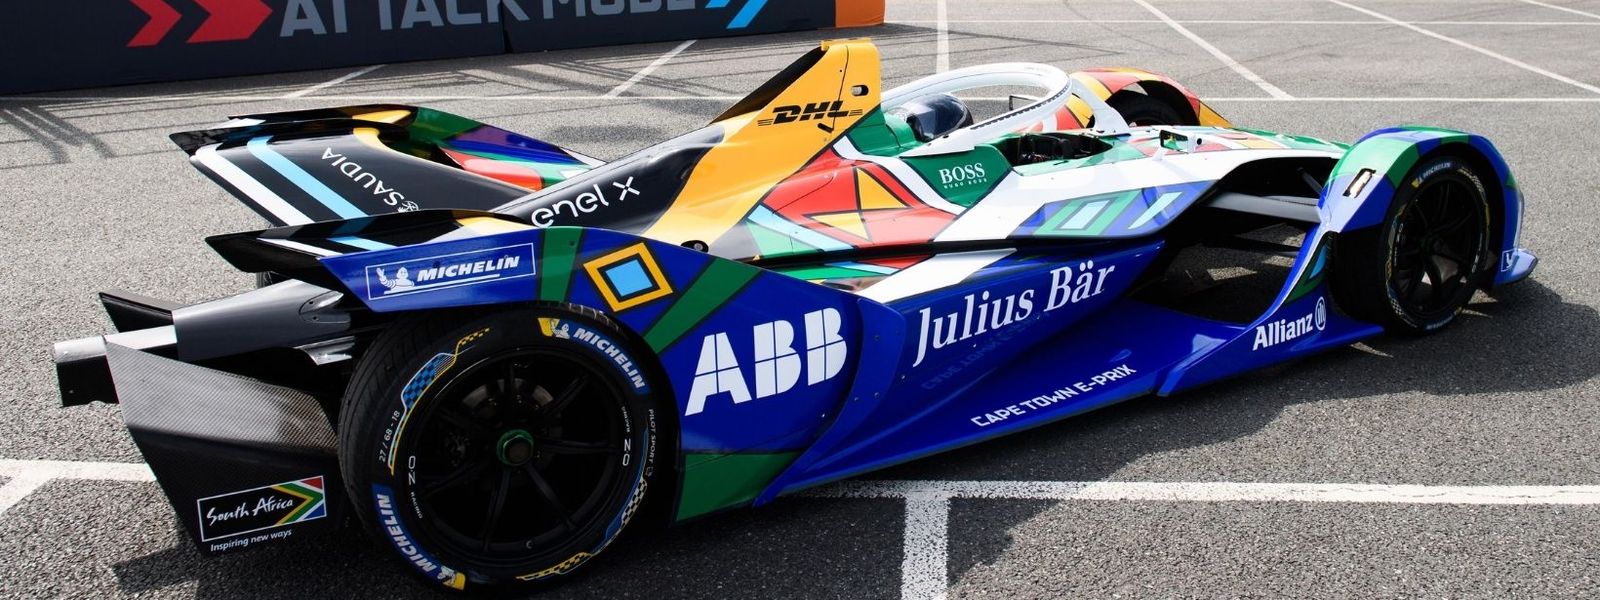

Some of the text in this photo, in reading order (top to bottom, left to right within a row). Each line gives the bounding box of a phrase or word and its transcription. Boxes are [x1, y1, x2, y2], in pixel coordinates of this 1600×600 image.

[772, 101, 849, 125] DHL
[321, 147, 405, 206] SAUDIA
[938, 162, 986, 184] BOSS
[943, 177, 988, 189] HUGO BOSS
[531, 184, 609, 228] enel
[417, 255, 520, 282] MICHELIN
[912, 289, 1035, 368] Julius
[1043, 260, 1116, 313] Bär
[1252, 312, 1314, 351] Allianz
[573, 327, 646, 389] MICHELIN
[684, 307, 848, 416] ABB
[970, 364, 1137, 427] CAPE TOWN E-PRIX
[648, 408, 657, 464] PILOT SPORT
[206, 495, 294, 527] South Africa
[376, 493, 438, 572] MICHELIN
[210, 528, 293, 552] Inspiring new ways
